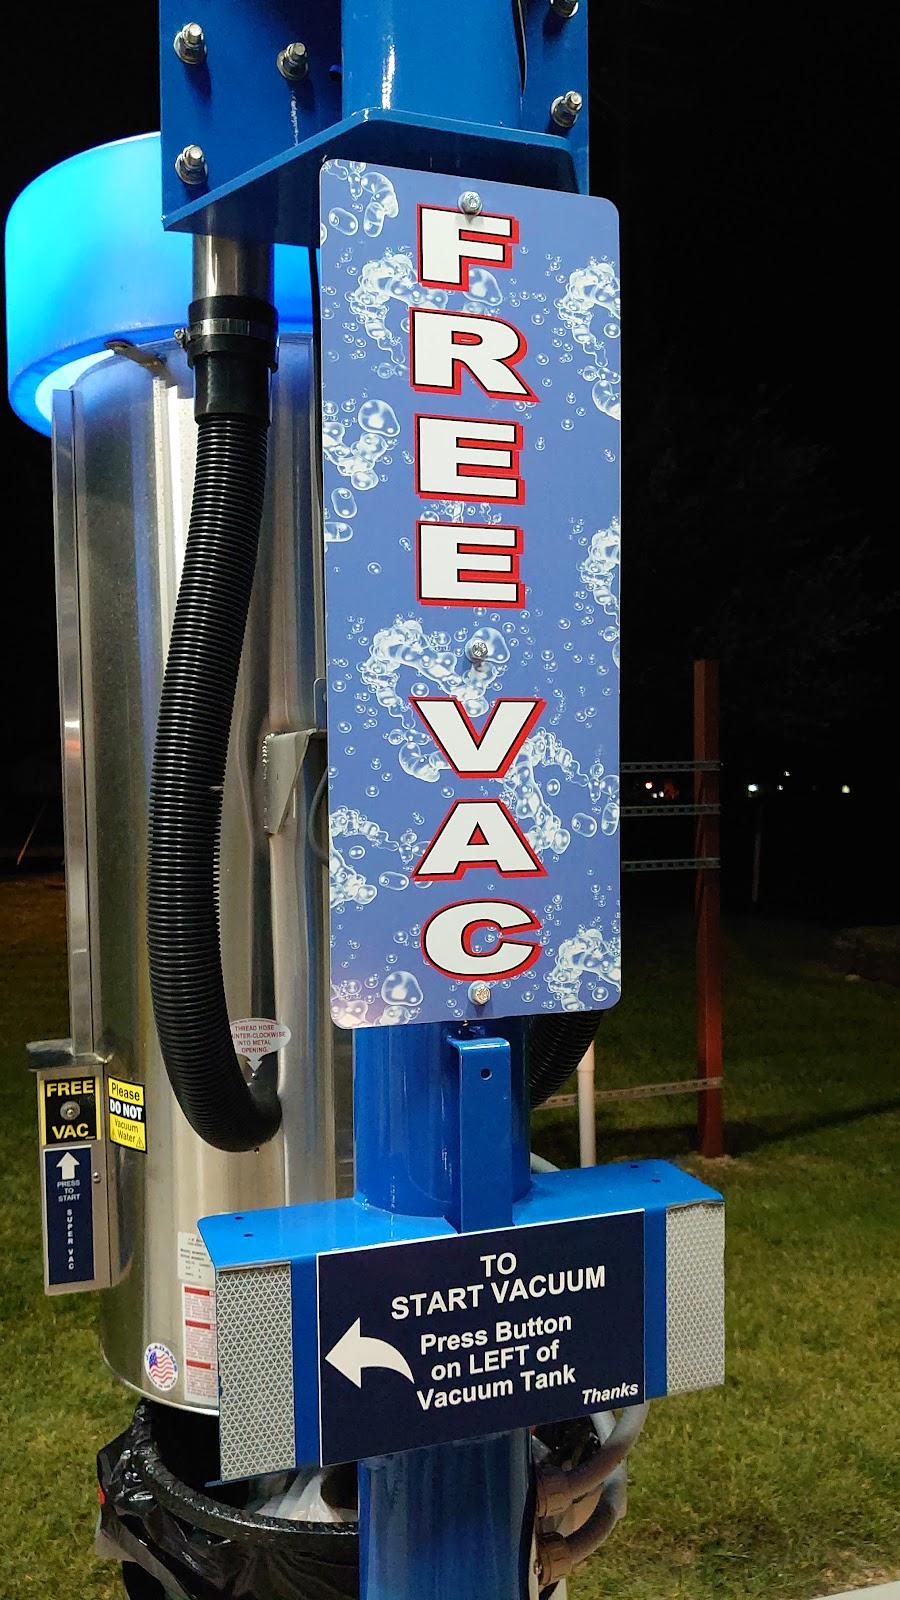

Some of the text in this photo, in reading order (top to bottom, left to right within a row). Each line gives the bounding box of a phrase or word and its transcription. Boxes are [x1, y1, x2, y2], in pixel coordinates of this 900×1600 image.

[408, 204, 547, 981] FREE VAC
[46, 1080, 94, 1098] FREE
[111, 1082, 140, 1101] Please
[110, 1099, 142, 1120] DO NOT
[52, 1123, 89, 1139] VAC
[114, 1118, 139, 1133] Vacuum
[117, 1129, 136, 1143] Water
[57, 1180, 80, 1188] PRESS
[64, 1187, 75, 1195] TO
[58, 1193, 80, 1203] START
[66, 1208, 74, 1245] SUPER
[480, 1252, 517, 1278] TO
[391, 1265, 606, 1320] START VACUUM
[420, 1315, 572, 1355] Press Button
[431, 1339, 560, 1381] on LEFT of
[416, 1363, 577, 1411] Vacuum Tank
[581, 1382, 639, 1405] Thanks
